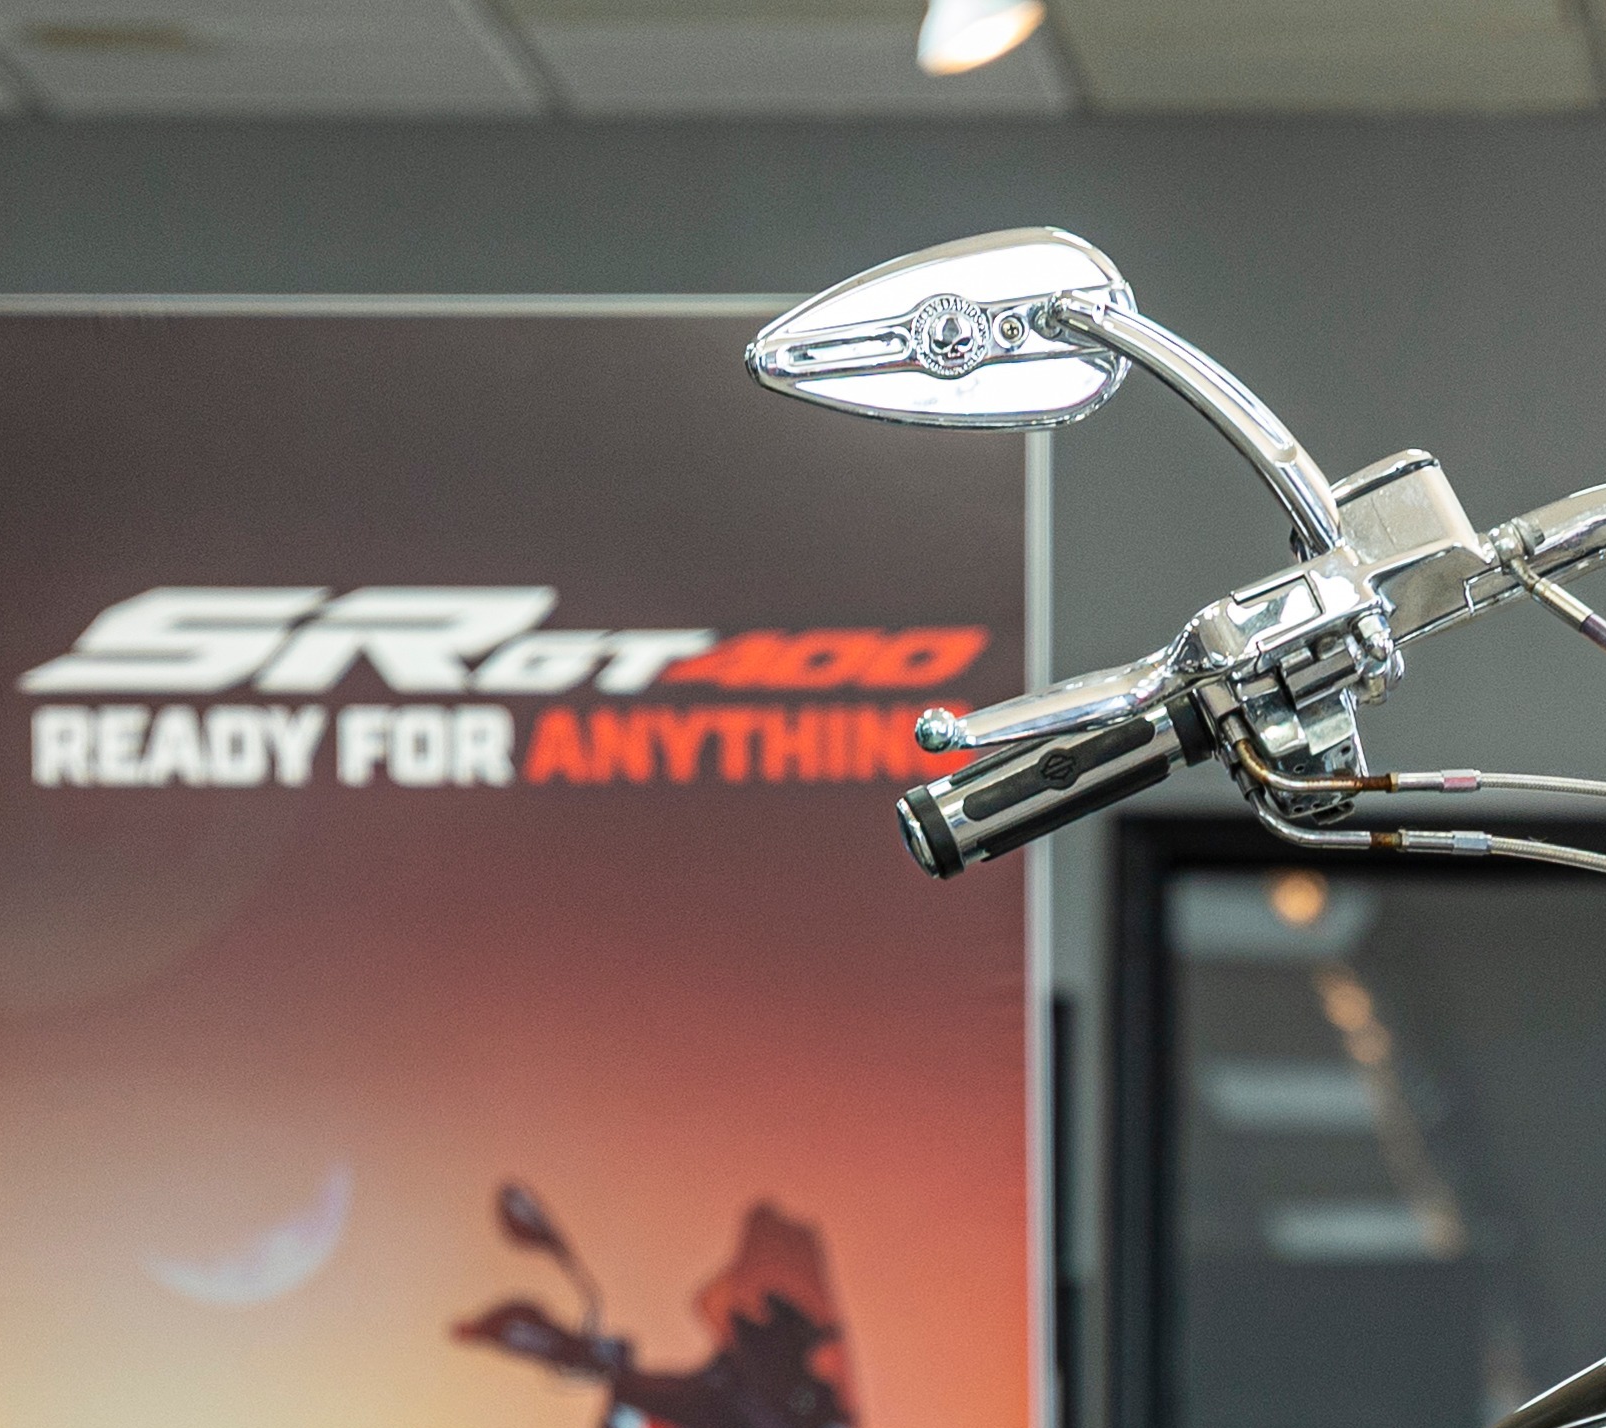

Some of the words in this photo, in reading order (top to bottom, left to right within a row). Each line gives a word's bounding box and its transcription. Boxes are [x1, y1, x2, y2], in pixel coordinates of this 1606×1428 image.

[20, 585, 560, 694] SR
[32, 704, 328, 787] READY
[337, 704, 516, 787] FOR
